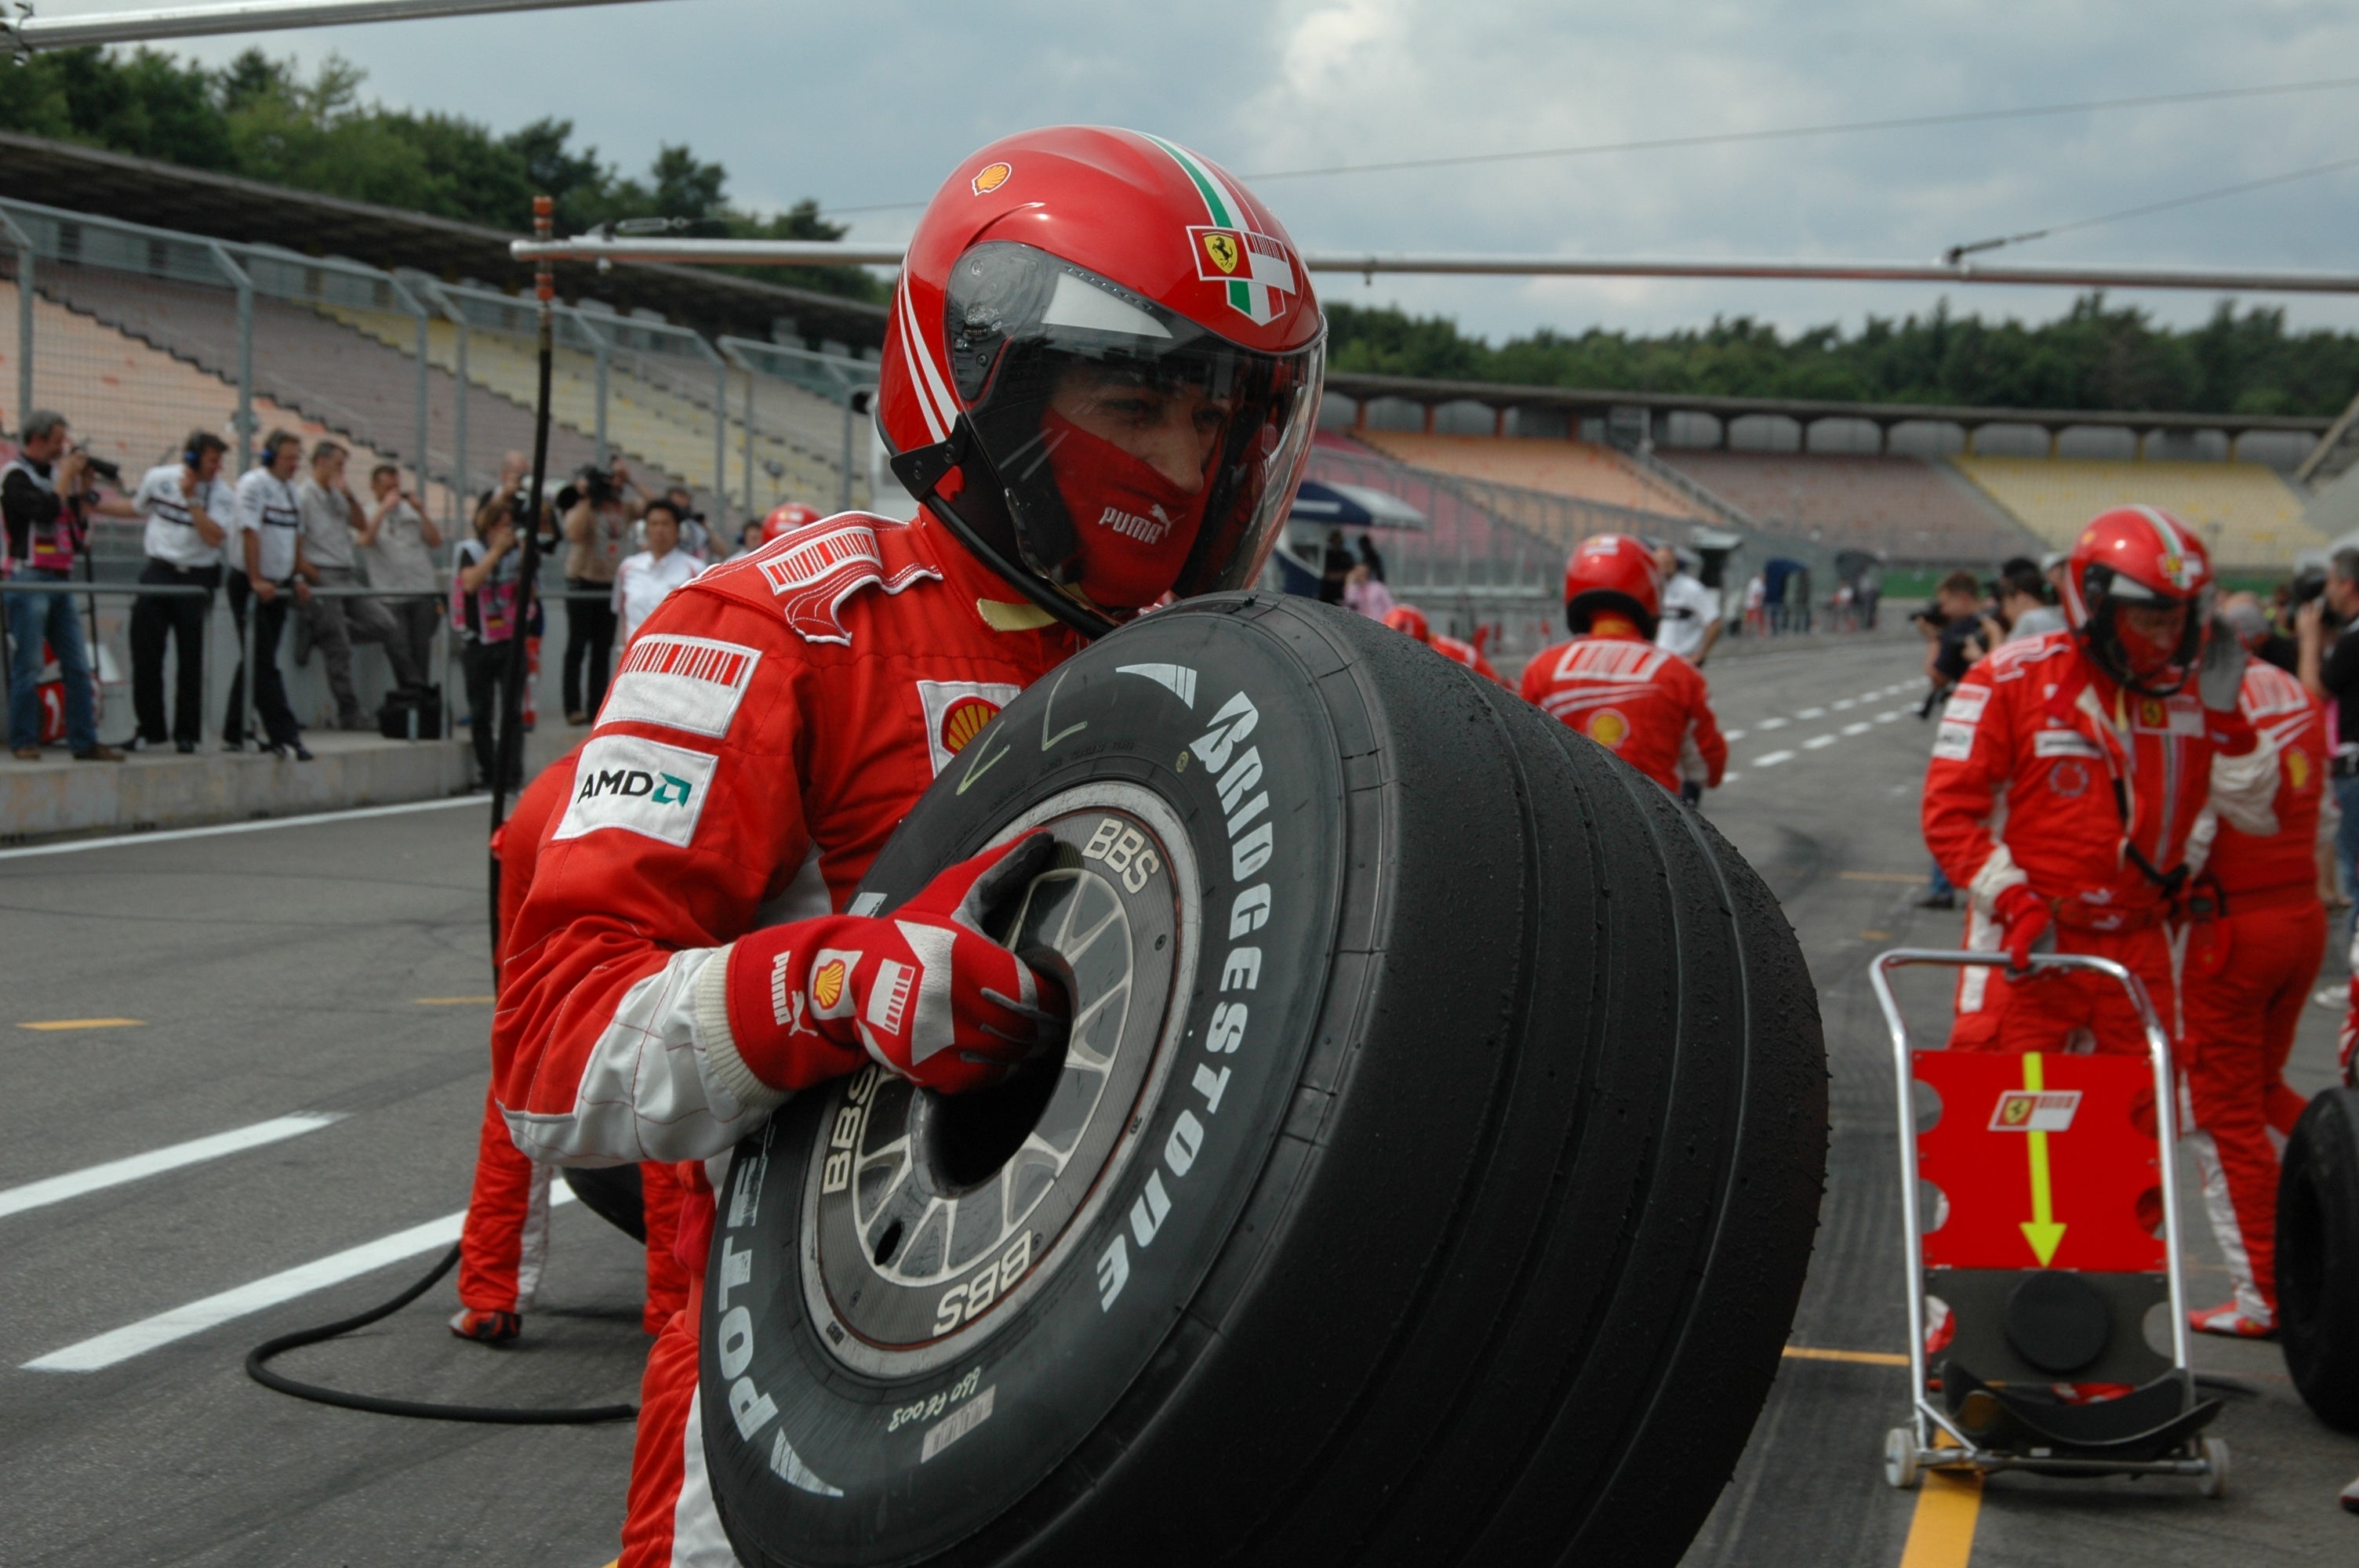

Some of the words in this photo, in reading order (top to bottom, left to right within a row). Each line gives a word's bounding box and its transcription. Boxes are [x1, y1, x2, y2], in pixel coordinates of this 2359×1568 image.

[1099, 506, 1163, 545] PUMA
[576, 770, 654, 804] AMD
[1081, 818, 1160, 893] BBS
[771, 950, 791, 1025] PUMA
[1097, 691, 1274, 1312] BRIDGESTONE
[823, 1065, 877, 1194] BBS
[932, 1229, 1032, 1335] BBS
